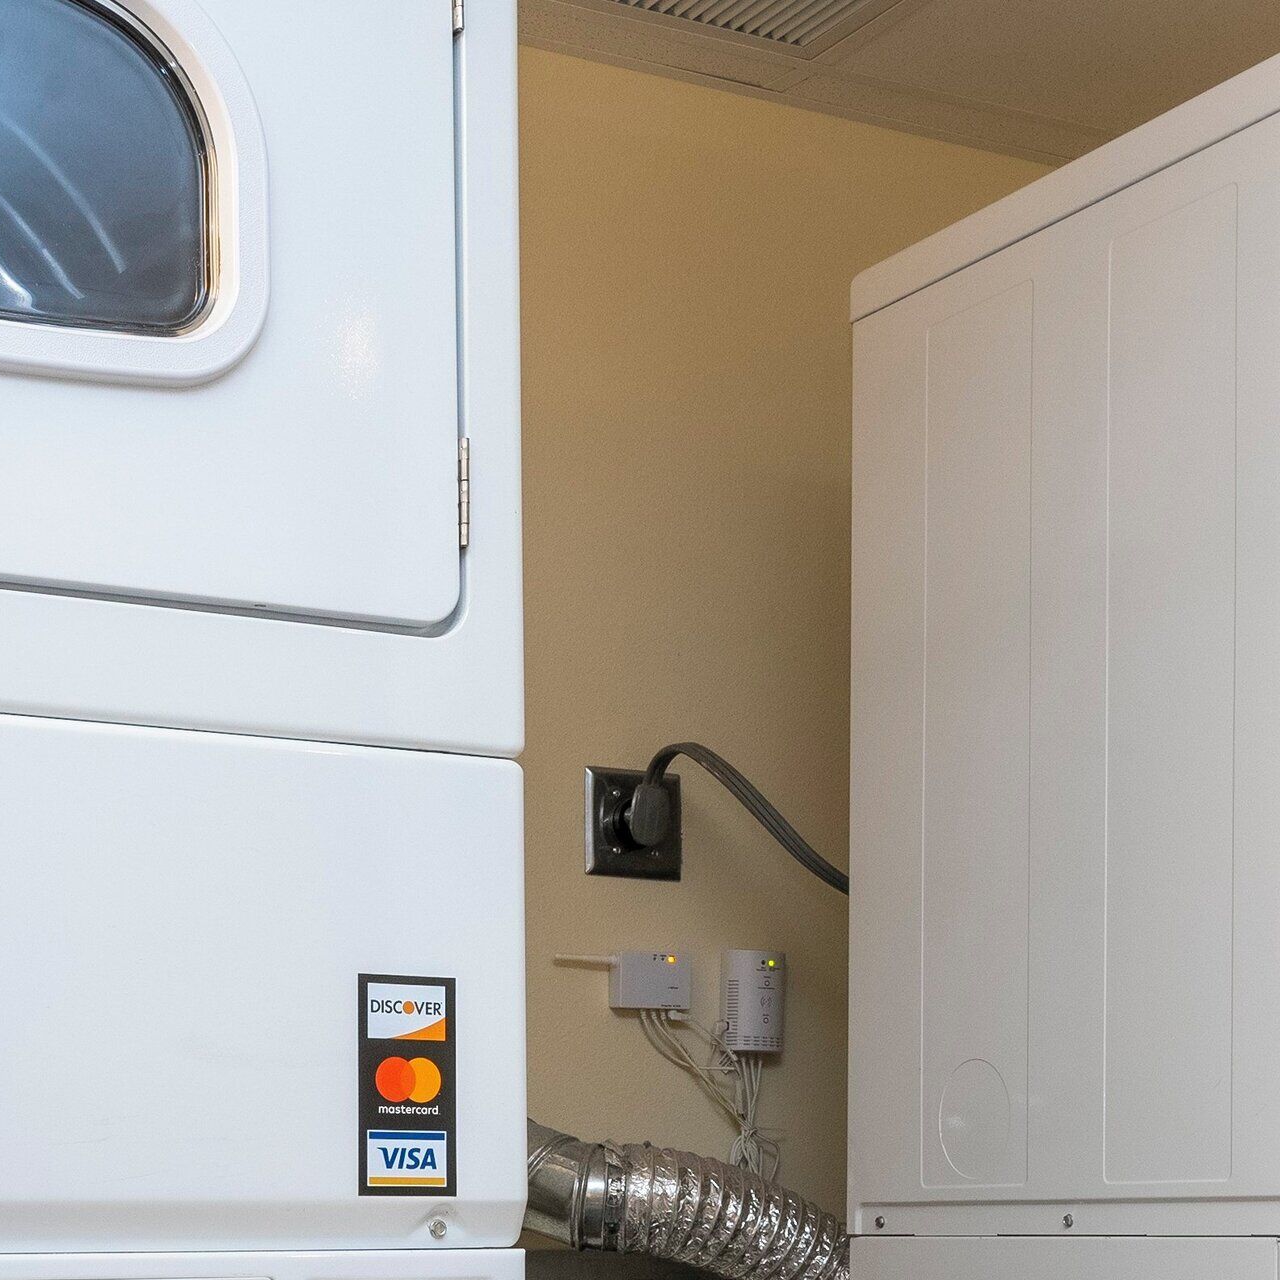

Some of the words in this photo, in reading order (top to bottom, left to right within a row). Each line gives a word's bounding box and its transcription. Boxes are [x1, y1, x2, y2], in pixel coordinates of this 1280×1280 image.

[370, 1000, 442, 1016] DISCOVER
[379, 1105, 440, 1115] mastercard
[377, 1147, 437, 1169] VISA
